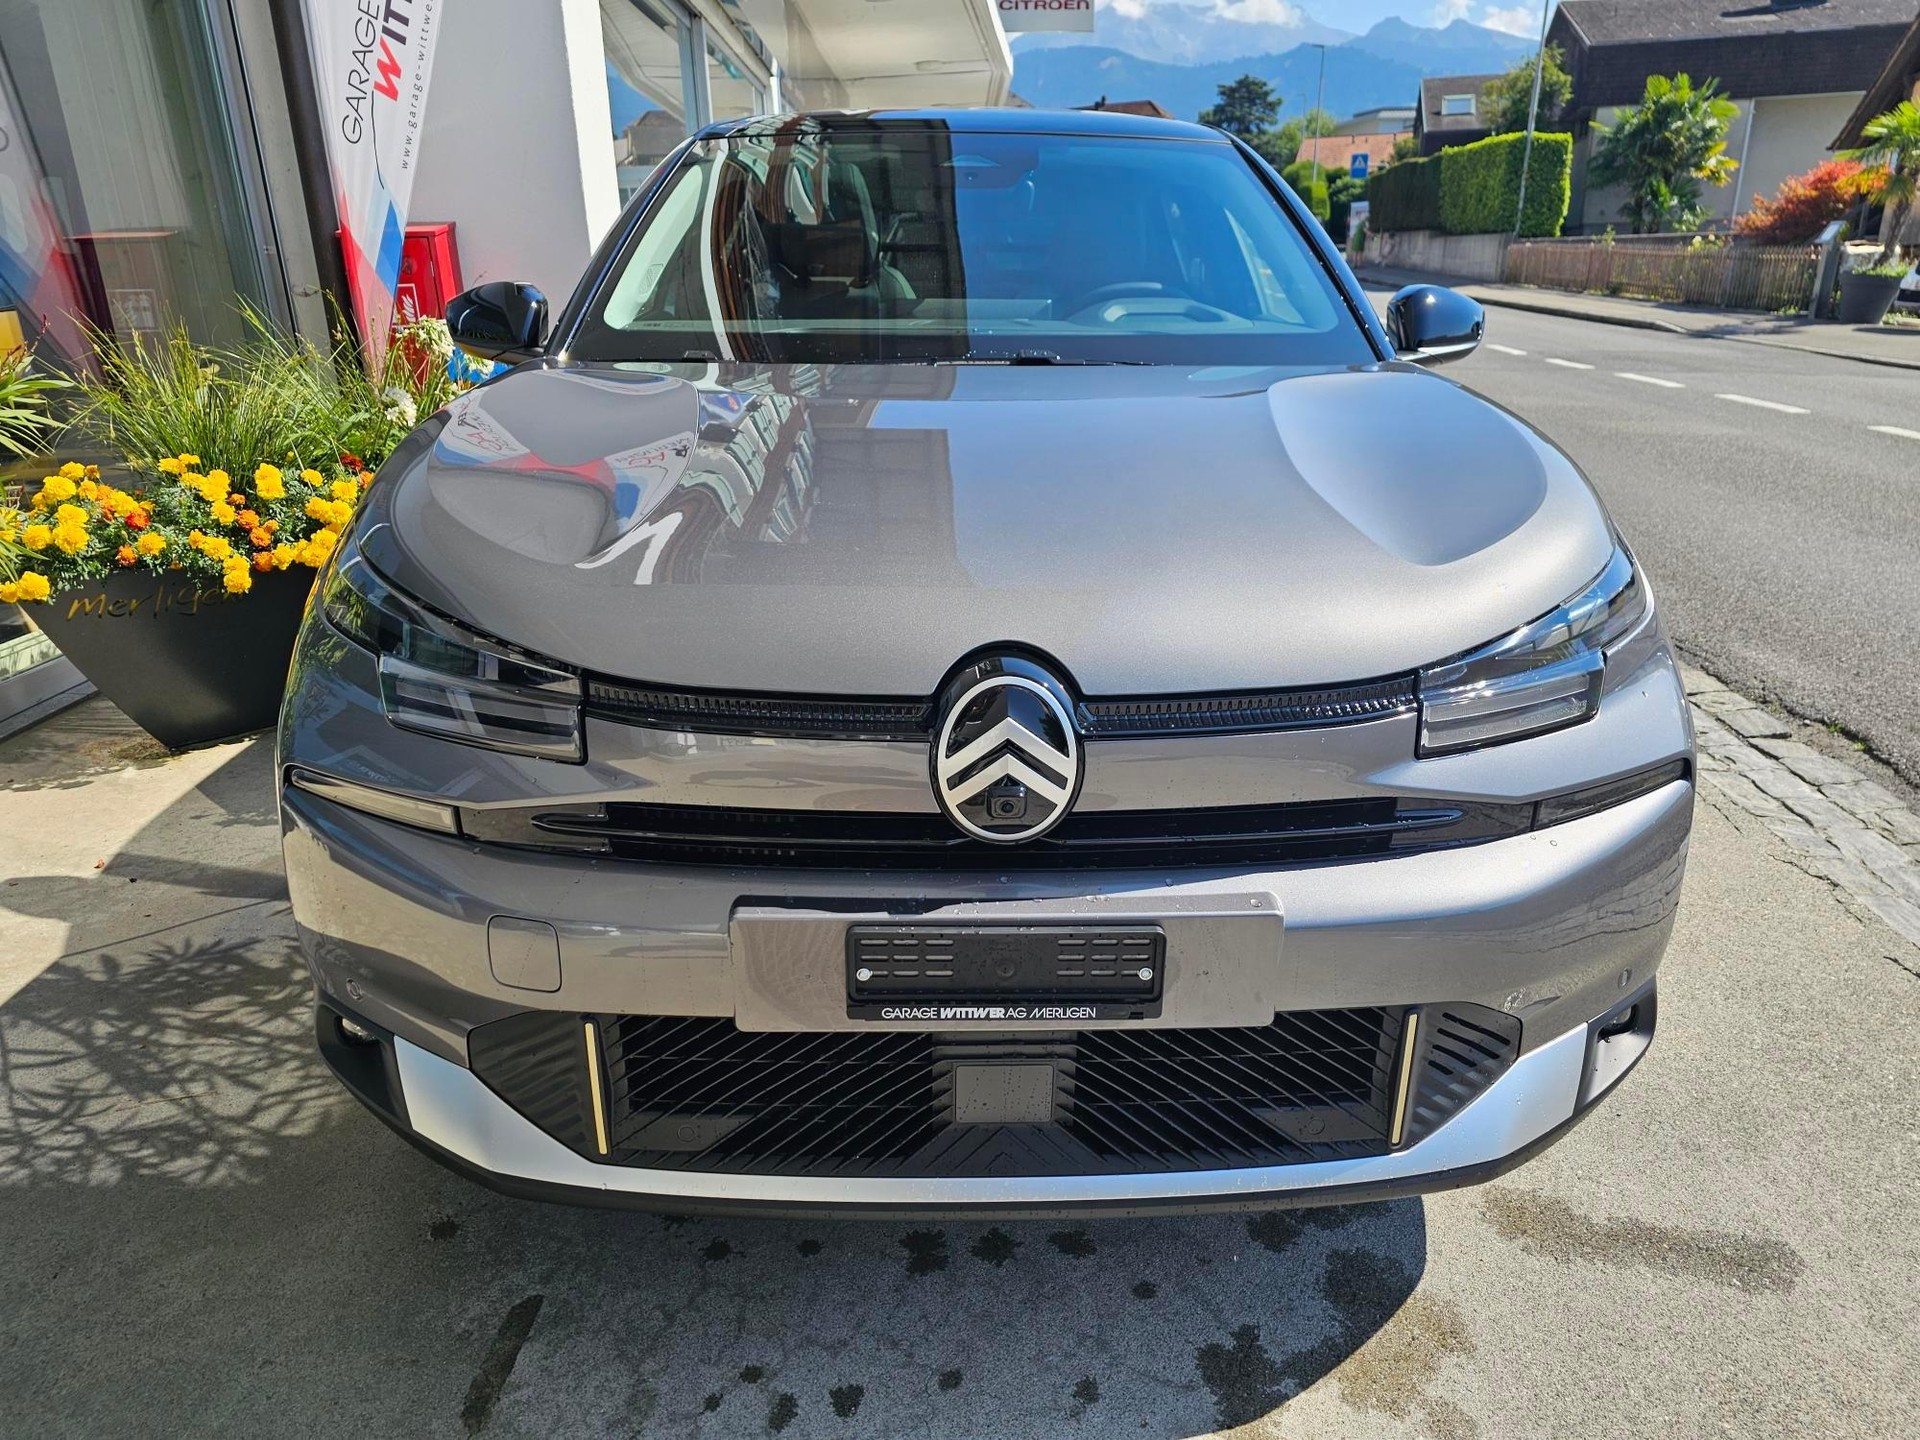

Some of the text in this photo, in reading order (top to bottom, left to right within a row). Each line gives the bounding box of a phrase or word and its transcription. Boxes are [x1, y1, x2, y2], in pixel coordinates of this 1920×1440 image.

[341, 0, 380, 144] GARAGE
[373, 0, 413, 102] WIT
[401, 0, 435, 170] www.garage-wittwe
[881, 1007, 1097, 1019] GARAGE WITTWER AG MERLIGEN
